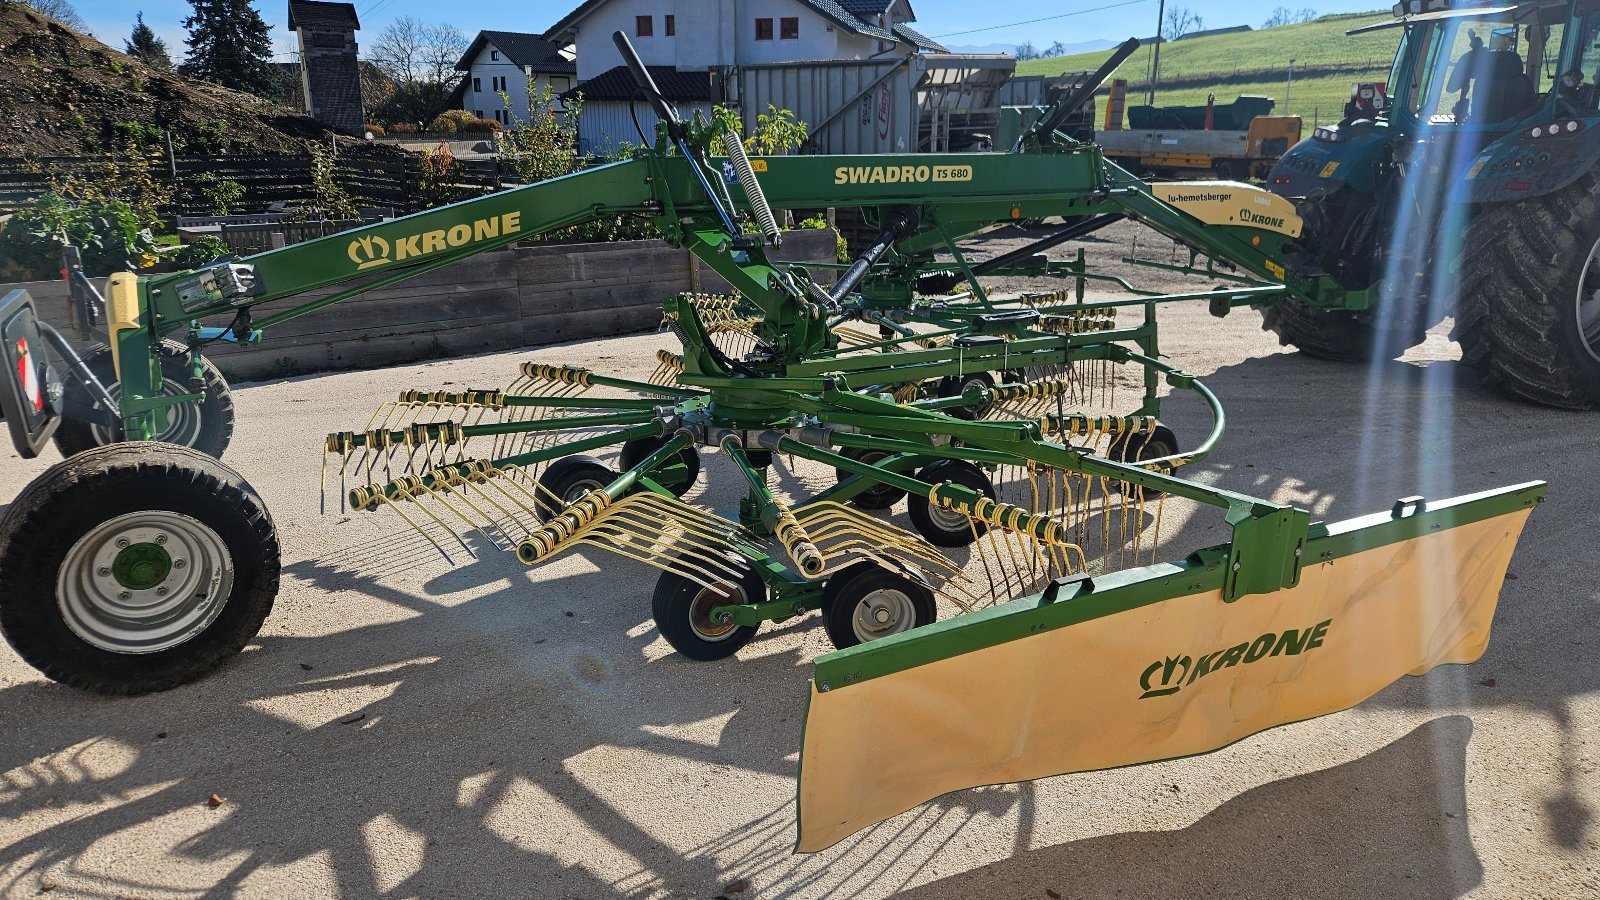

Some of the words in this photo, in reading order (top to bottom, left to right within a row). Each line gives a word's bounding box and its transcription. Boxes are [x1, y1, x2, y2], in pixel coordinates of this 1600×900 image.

[834, 165, 930, 184] SWADRO
[936, 169, 948, 178] TS
[950, 168, 969, 178] 680
[396, 211, 521, 261] KRONE
[1251, 213, 1285, 228] KRONE
[1185, 618, 1333, 687] KRONE
